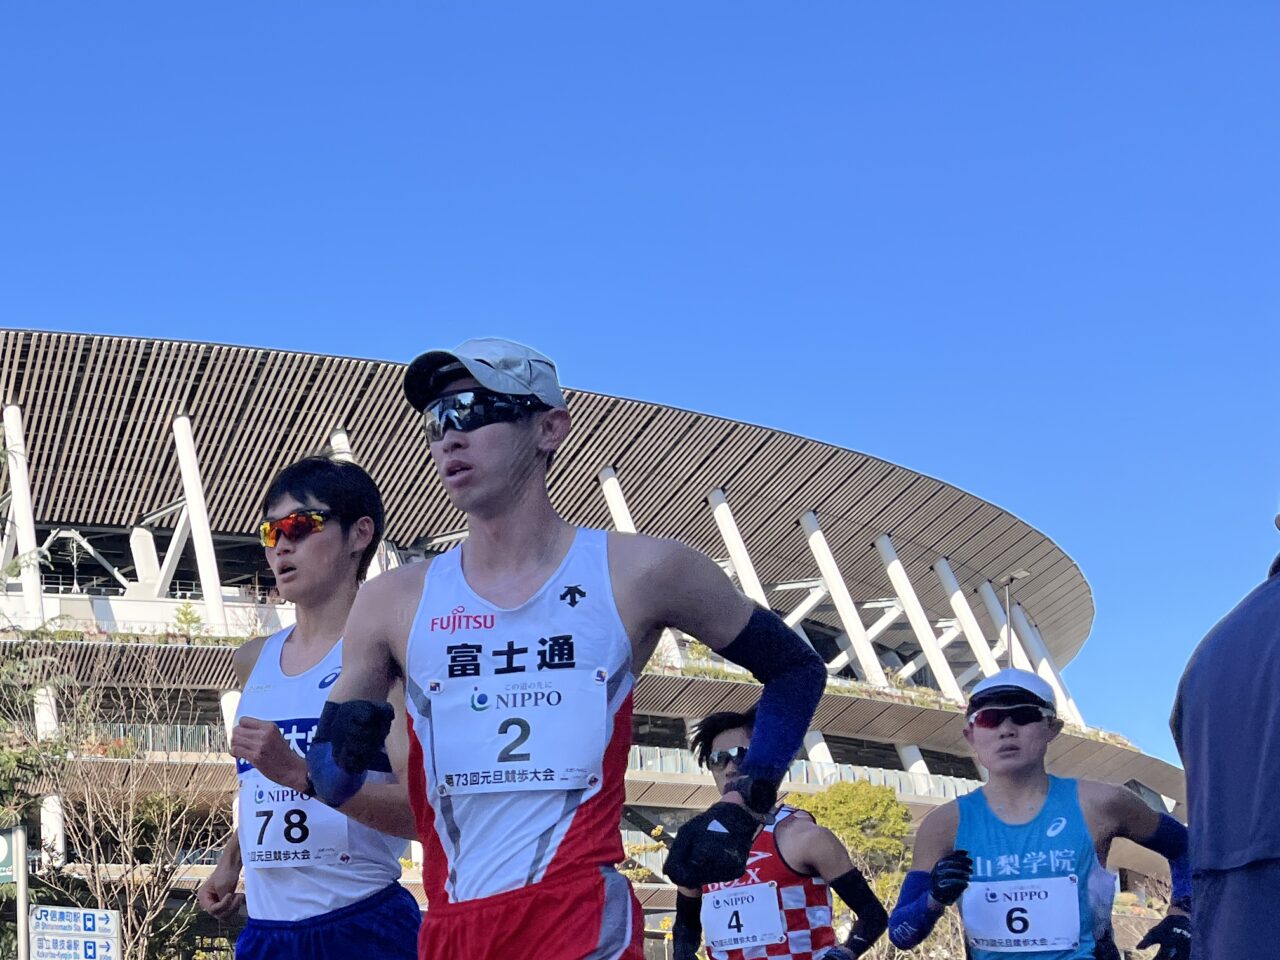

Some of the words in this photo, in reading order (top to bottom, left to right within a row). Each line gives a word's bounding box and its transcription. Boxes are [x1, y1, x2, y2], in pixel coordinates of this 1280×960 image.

[431, 606, 495, 634] FUJITSU
[446, 634, 576, 678] 富士通
[504, 681, 553, 691] この道の先に
[495, 690, 562, 709] NIPPO
[497, 717, 531, 763] 2
[255, 808, 310, 846] 78
[248, 849, 311, 862] 回元旦競歩大会
[723, 894, 755, 907] NIPPO
[1002, 890, 1049, 902] NIPPO
[728, 909, 744, 934] 4
[1006, 906, 1030, 934] 6
